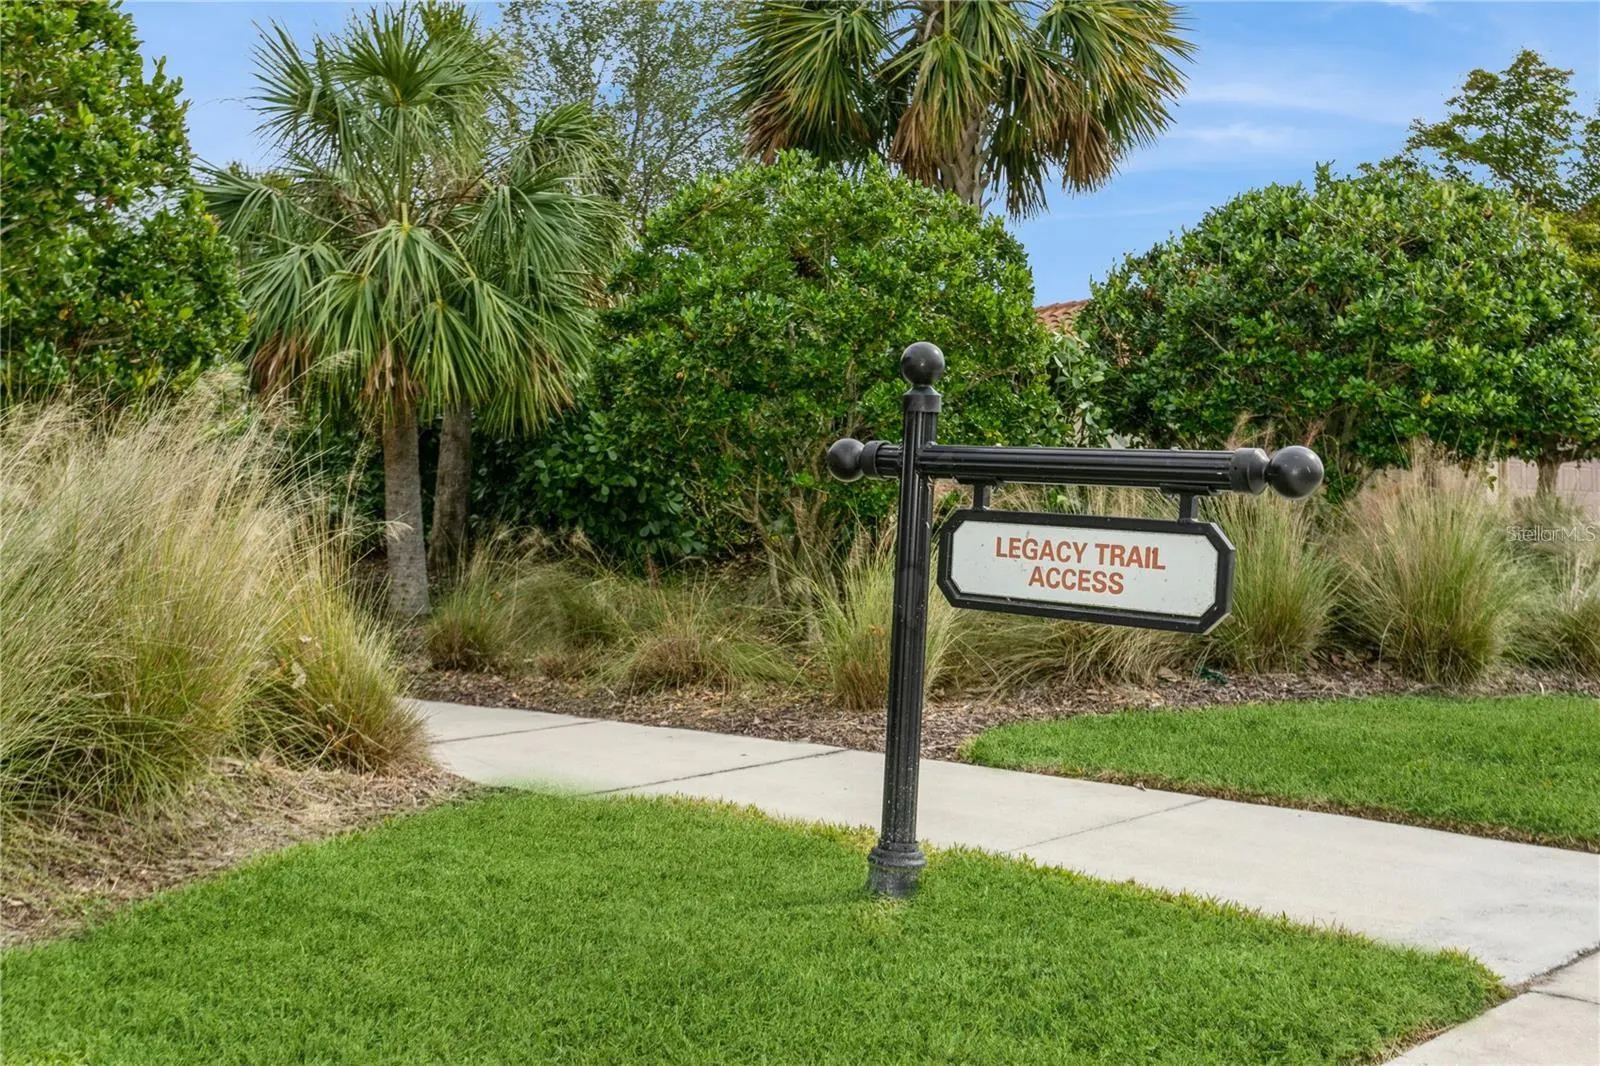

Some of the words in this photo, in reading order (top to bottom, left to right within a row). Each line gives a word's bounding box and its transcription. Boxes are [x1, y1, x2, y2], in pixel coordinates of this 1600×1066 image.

[996, 536, 1088, 563] LEGACY
[1095, 543, 1166, 570] TRAIL
[1028, 566, 1124, 595] ACCESS
